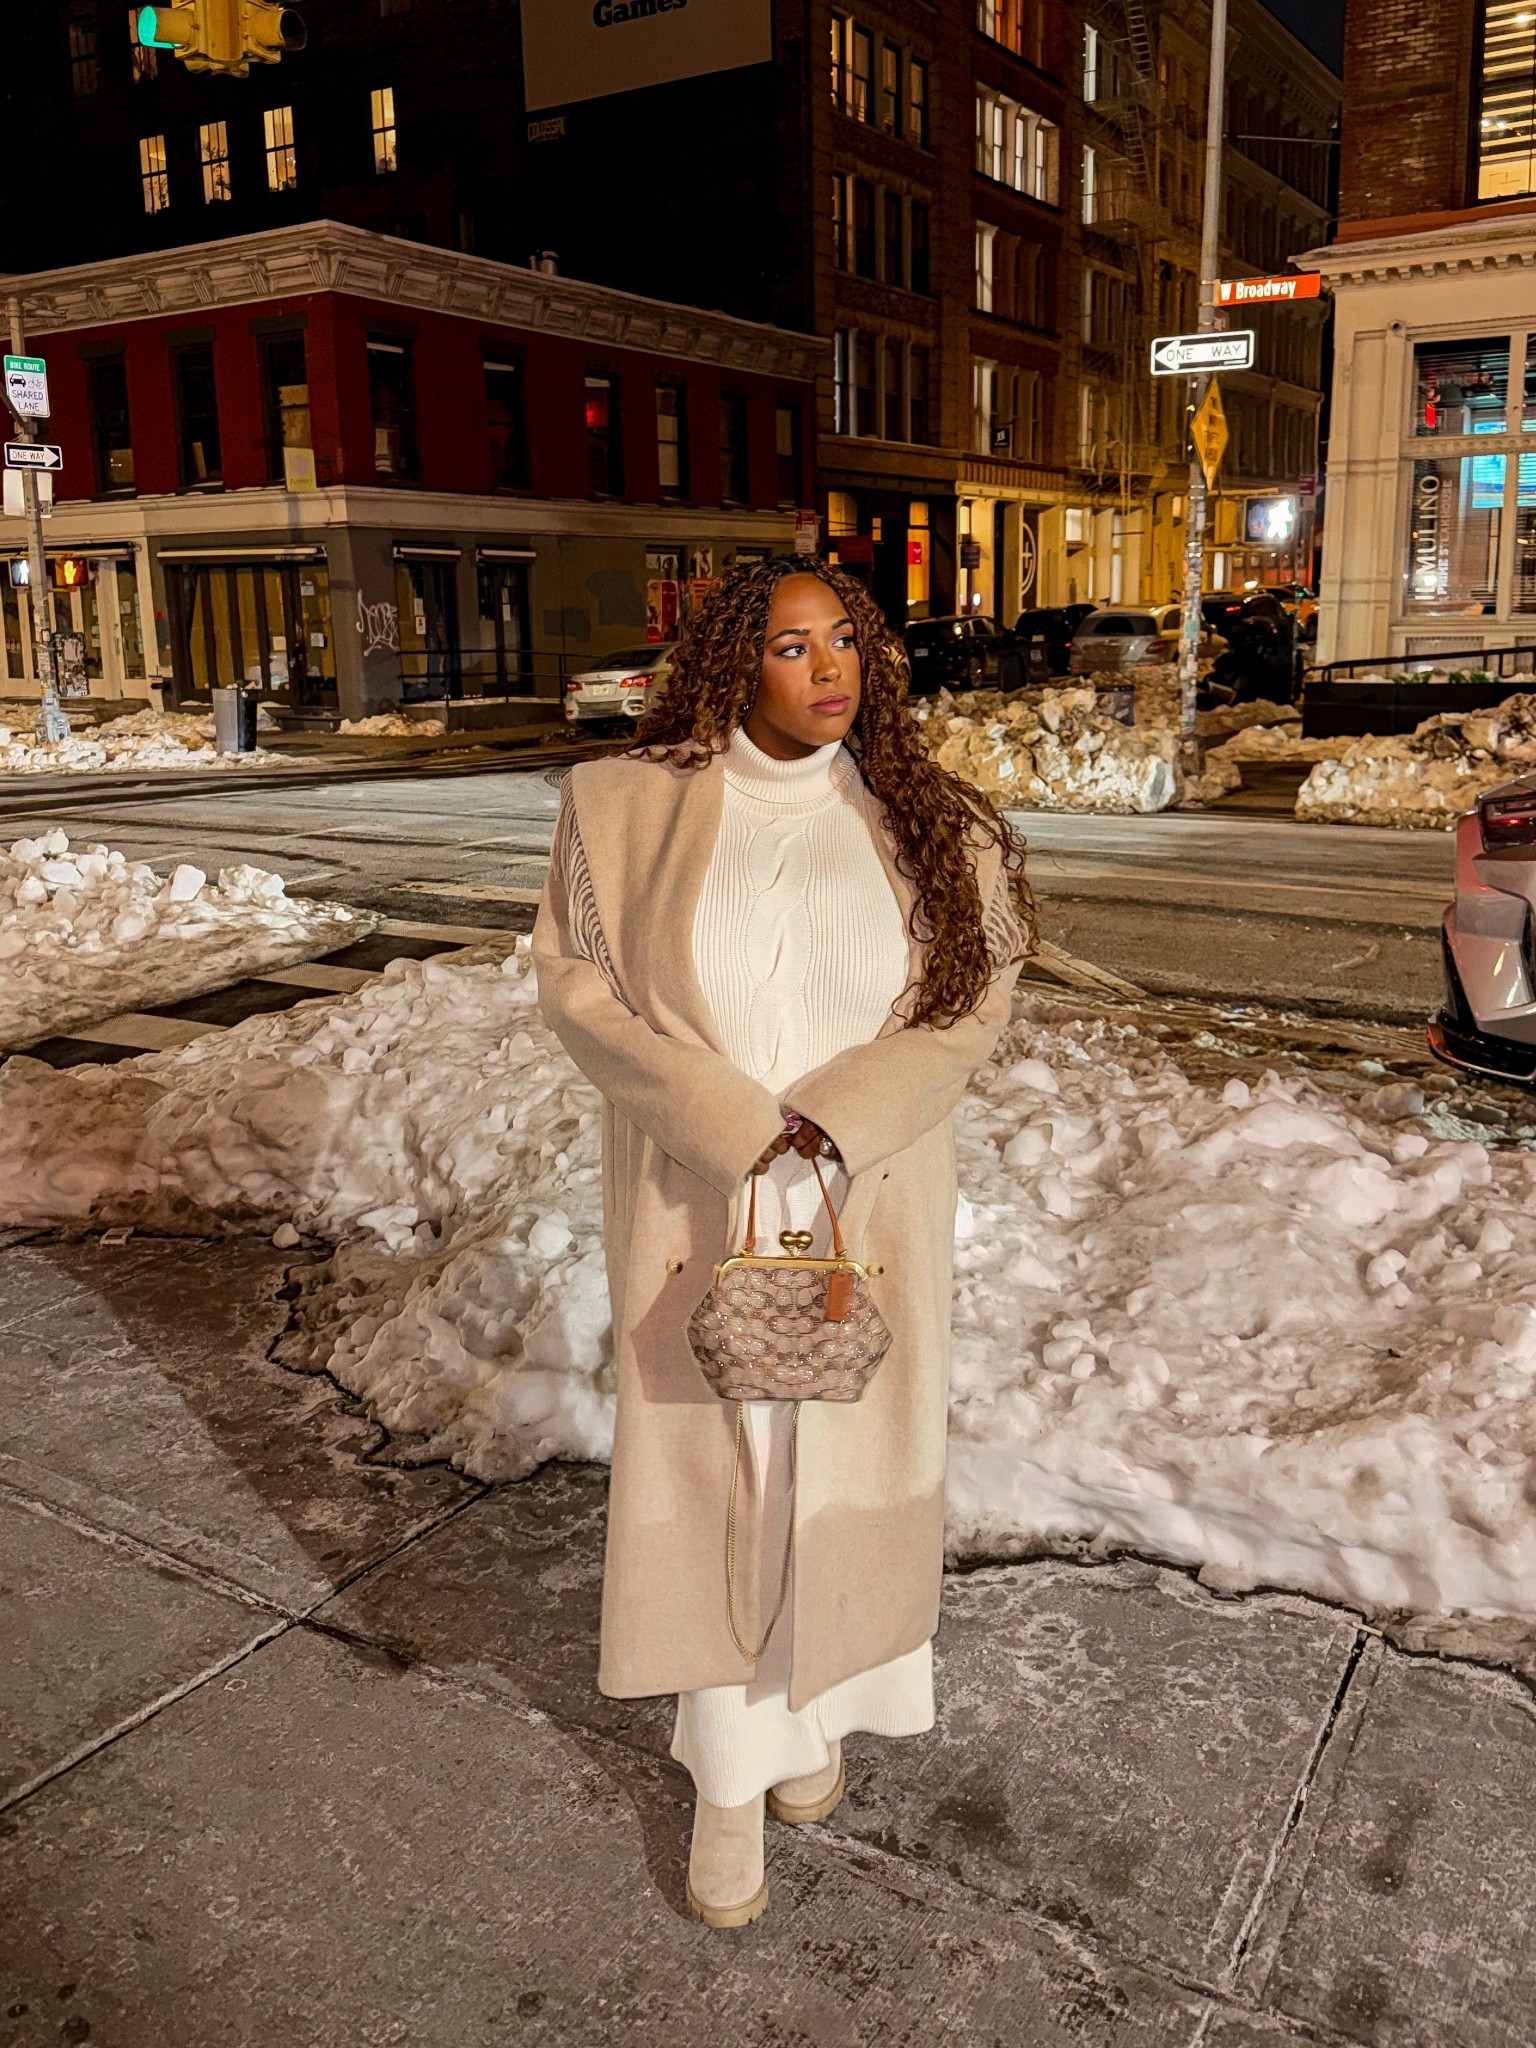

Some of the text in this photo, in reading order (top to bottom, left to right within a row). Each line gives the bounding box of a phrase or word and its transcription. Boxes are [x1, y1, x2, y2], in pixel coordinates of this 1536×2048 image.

[592, 0, 688, 28] Games
[1220, 279, 1297, 301] W Broadway
[1166, 344, 1242, 362] ONE WAY
[10, 360, 41, 372] BIKE ROUTE
[11, 389, 44, 401] SHARED
[18, 402, 40, 412] LANE
[12, 450, 45, 461] ONE WAY
[1416, 475, 1440, 576] MULINO
[1437, 479, 1453, 596] PRIME STEAKHOUSE
